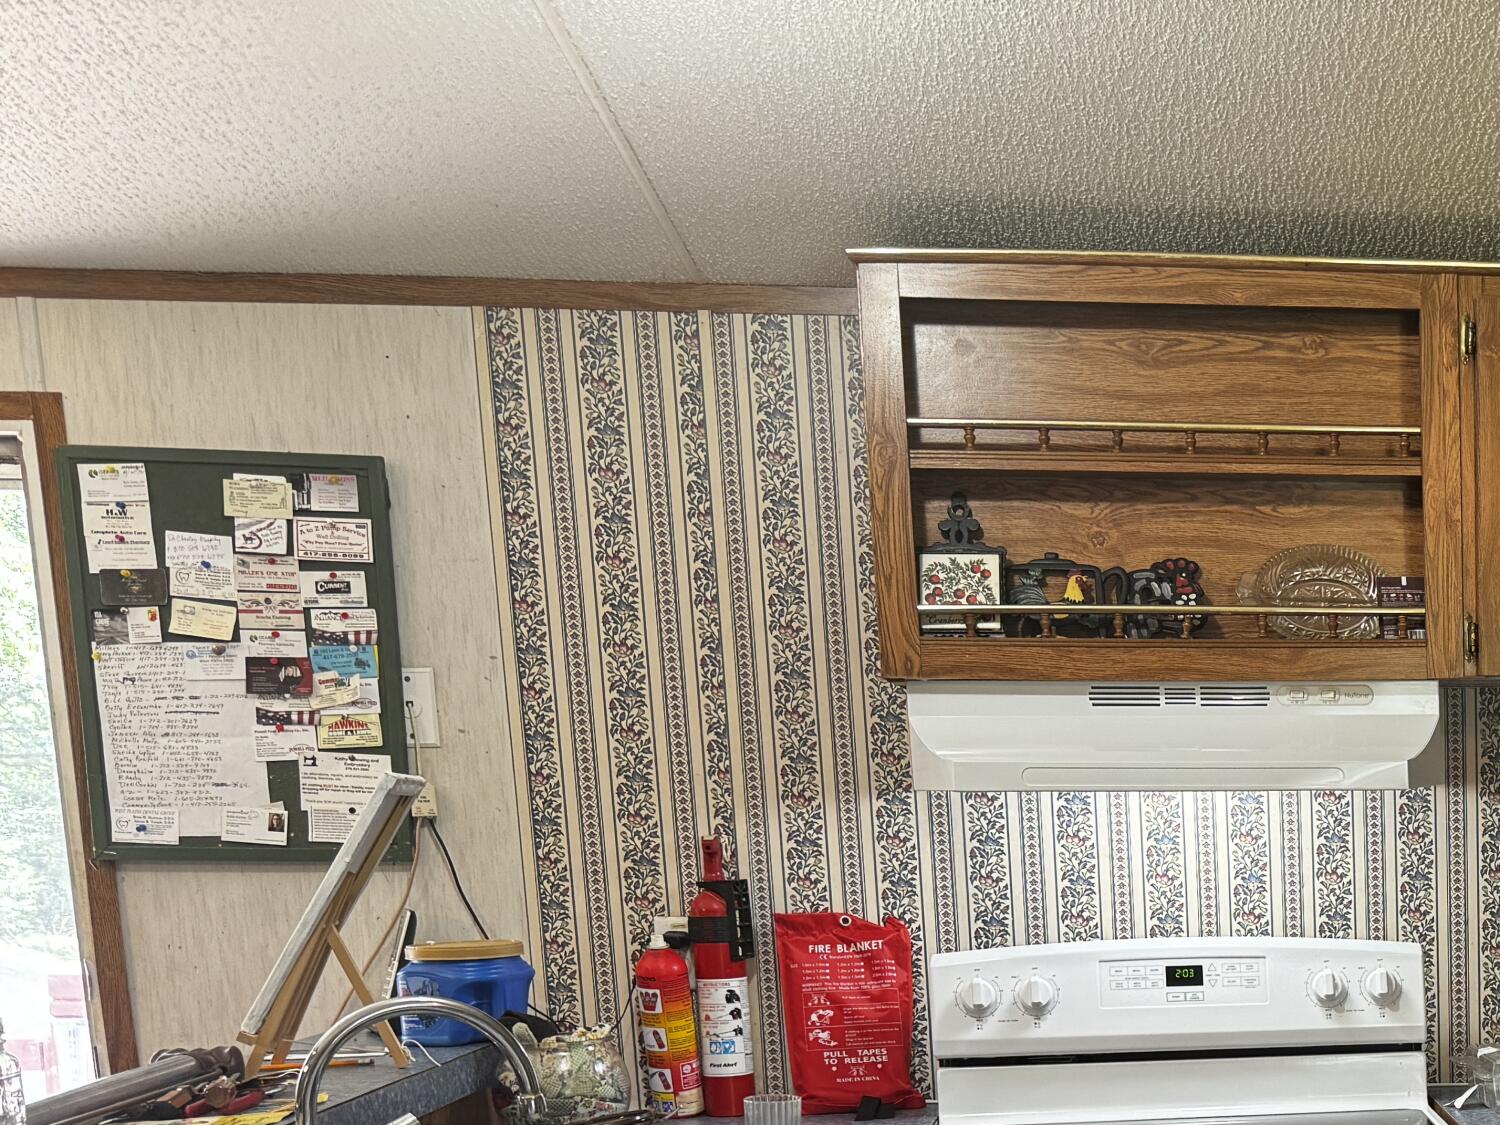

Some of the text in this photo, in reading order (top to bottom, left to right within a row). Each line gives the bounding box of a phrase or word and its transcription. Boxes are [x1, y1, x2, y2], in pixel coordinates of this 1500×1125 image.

[808, 940, 884, 954] FIRE BLANKET
[1175, 969, 1194, 978] 2:03
[857, 1048, 888, 1056] TAPES
[845, 1055, 889, 1065] RELEASE
